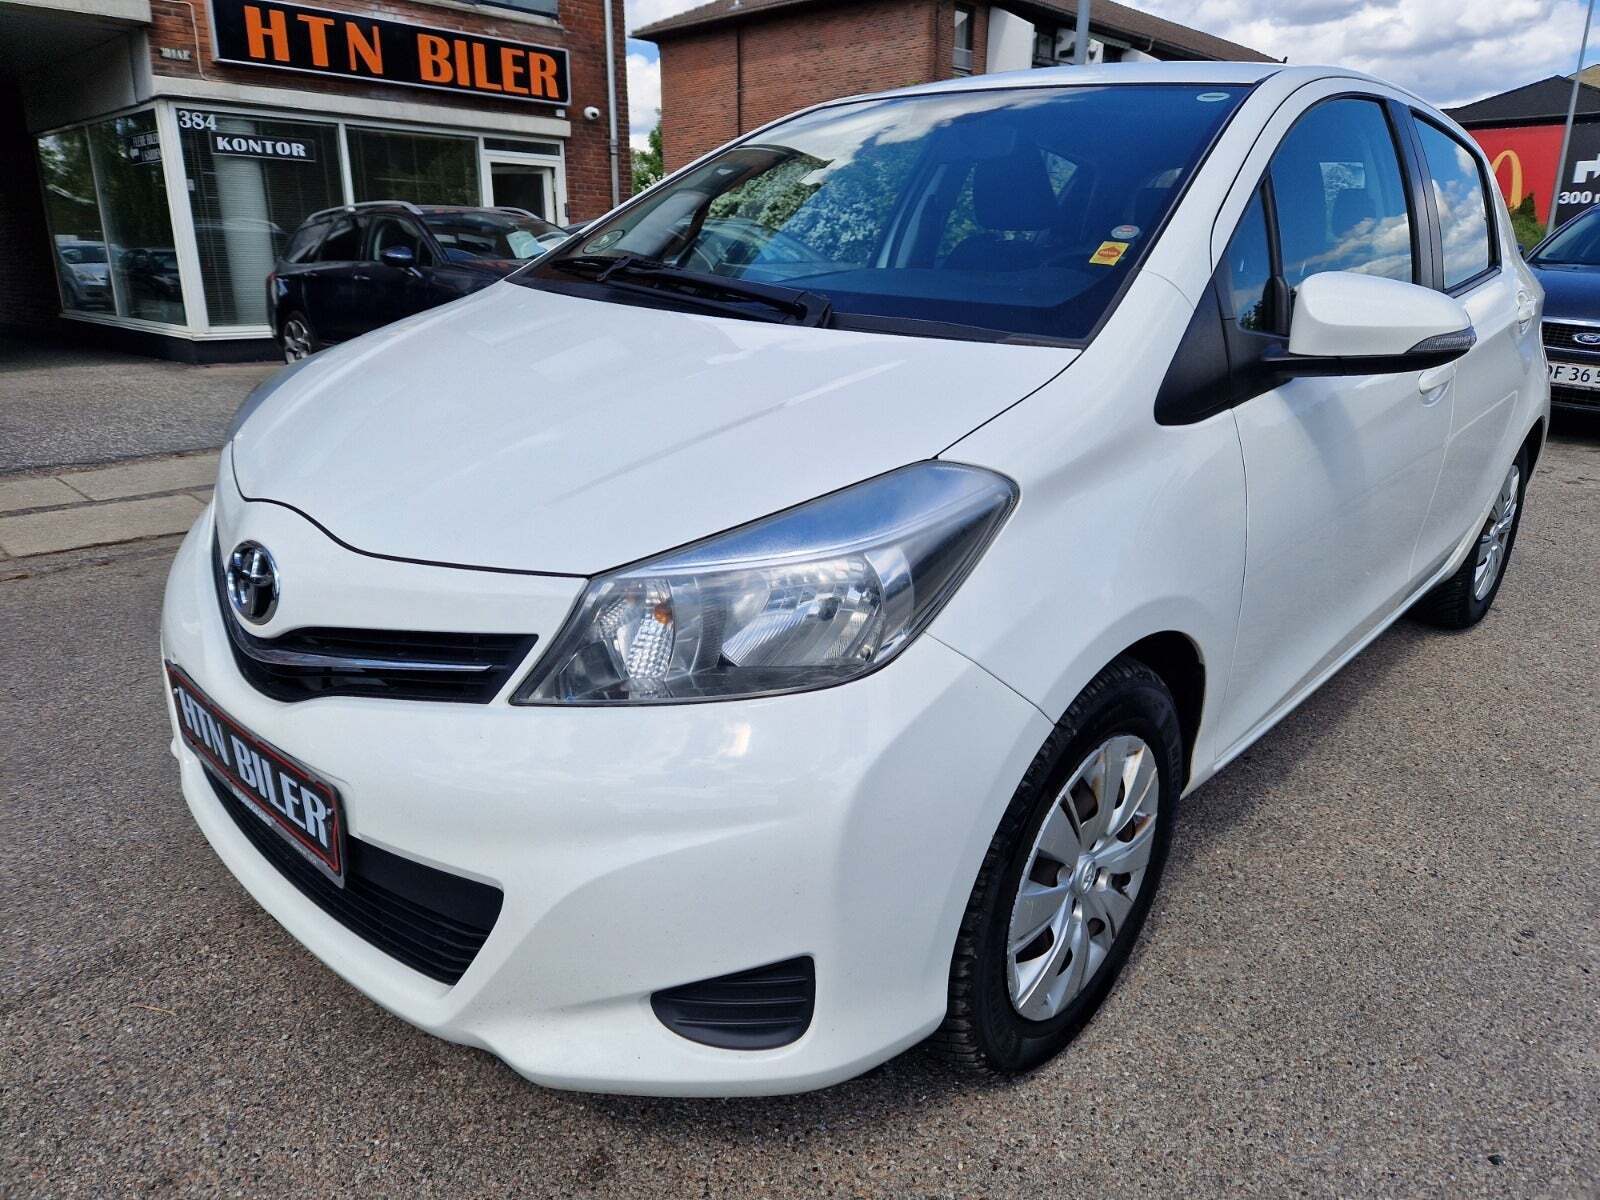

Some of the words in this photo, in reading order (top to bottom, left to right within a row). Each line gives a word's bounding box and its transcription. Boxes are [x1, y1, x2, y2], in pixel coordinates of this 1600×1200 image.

[243, 5, 384, 75] HTN
[416, 33, 559, 98] BILER
[178, 110, 217, 131] 384
[216, 136, 306, 157] KONTOR
[1558, 191, 1592, 205] 300
[1568, 367, 1591, 383] 36
[177, 686, 230, 767] HTN
[231, 734, 328, 848] BILER
